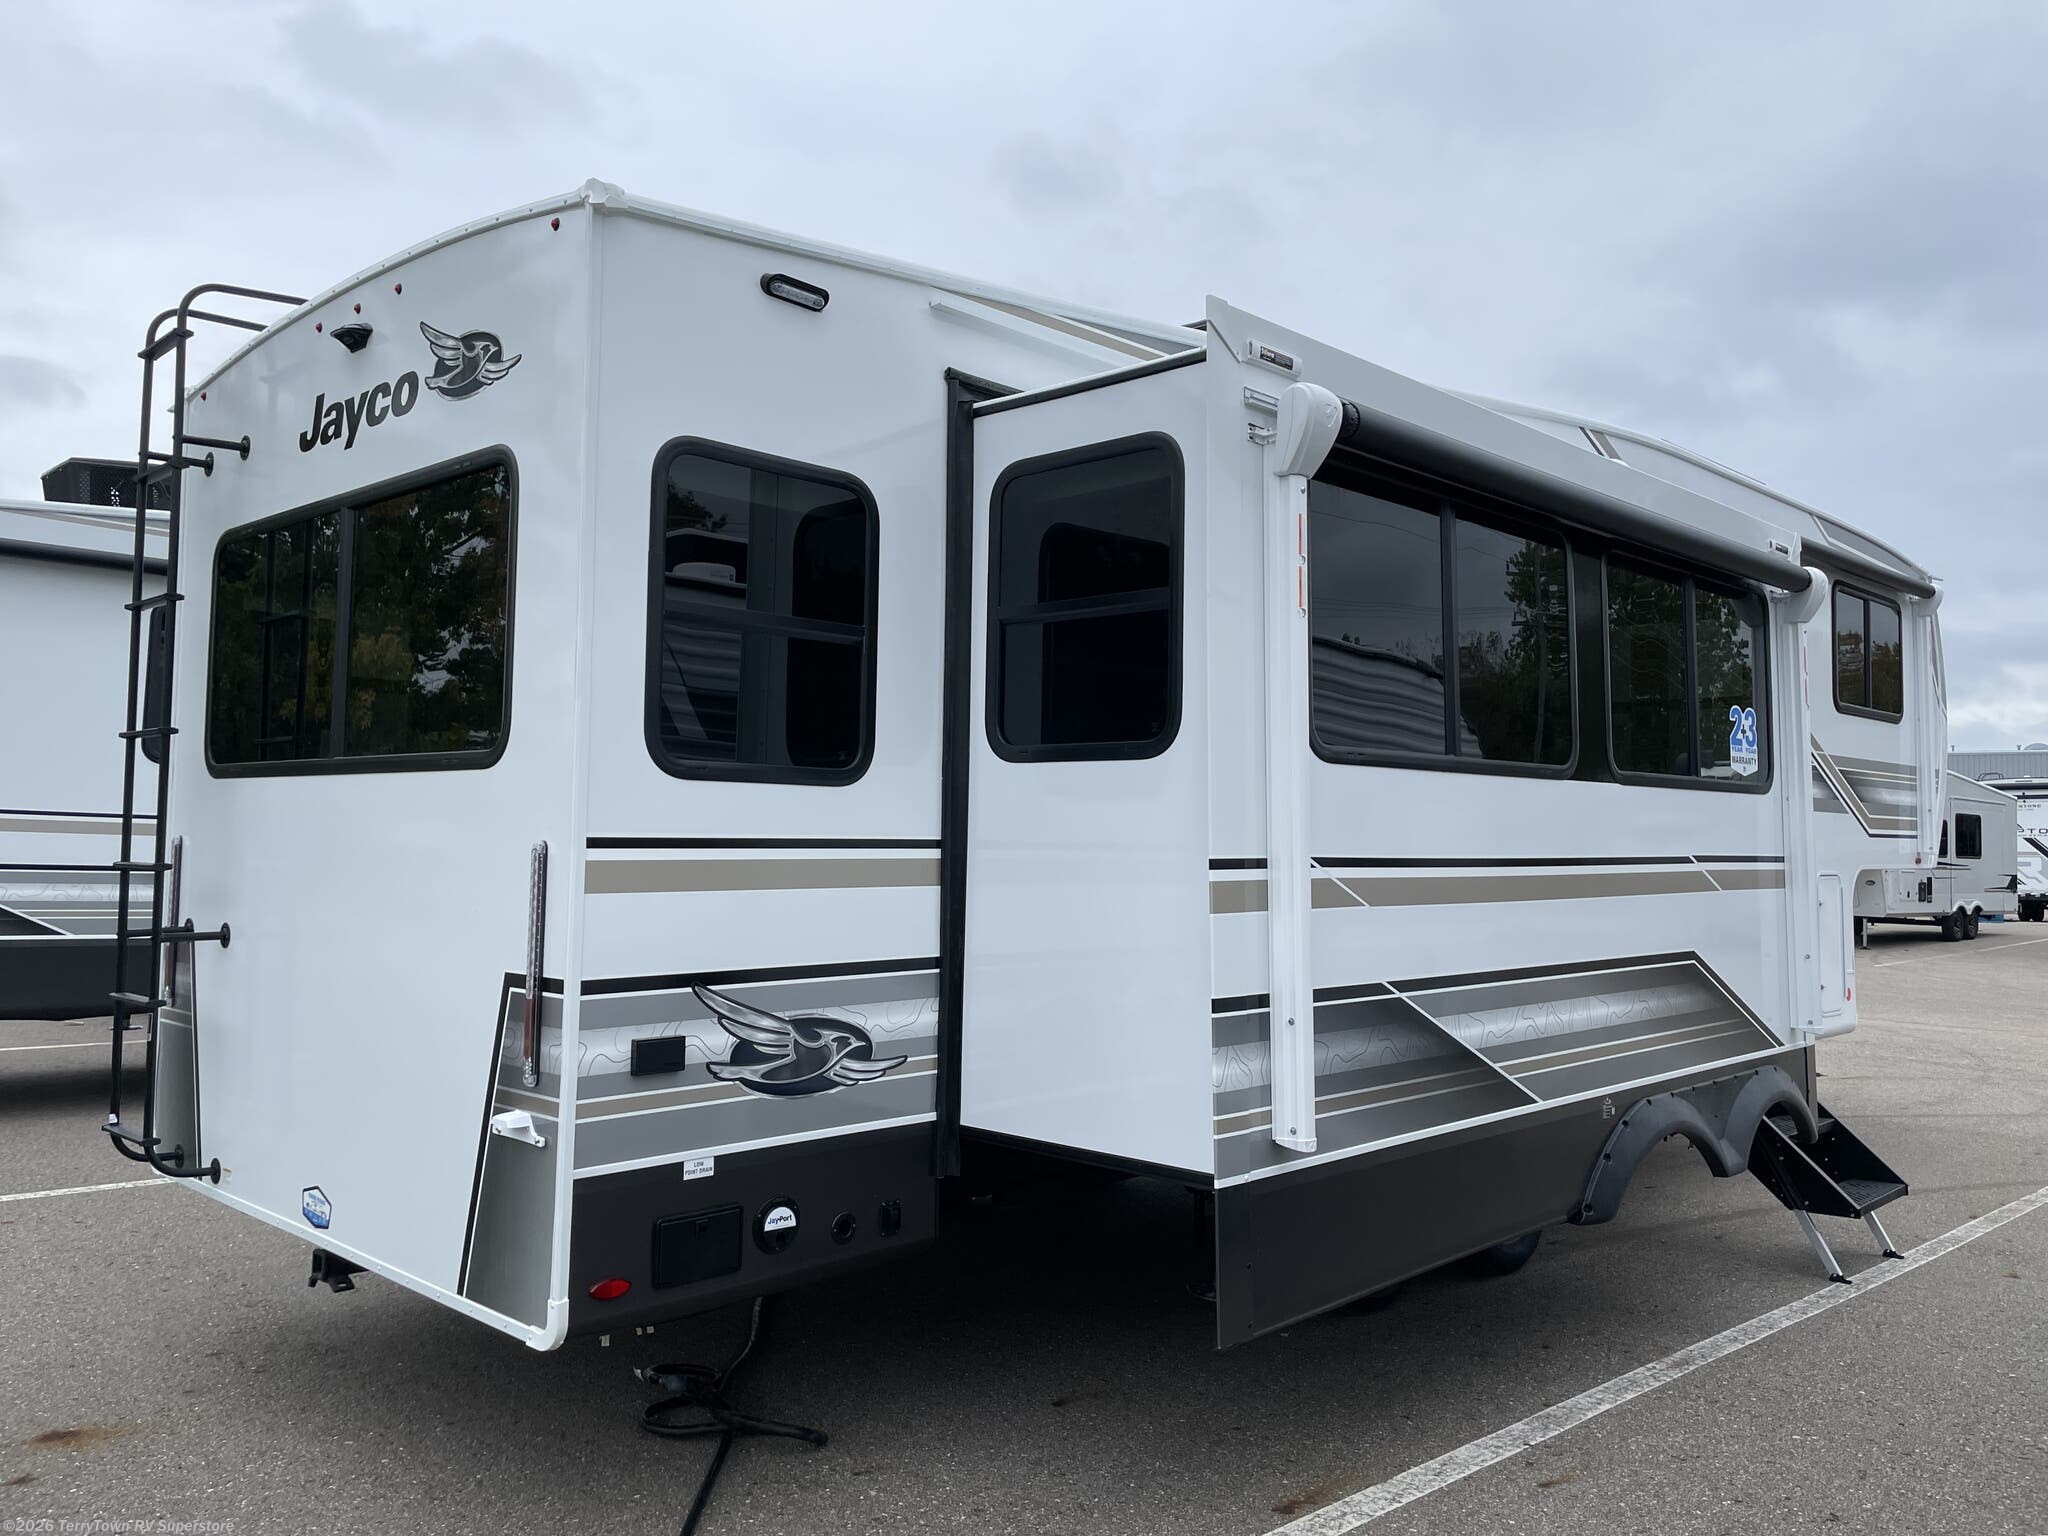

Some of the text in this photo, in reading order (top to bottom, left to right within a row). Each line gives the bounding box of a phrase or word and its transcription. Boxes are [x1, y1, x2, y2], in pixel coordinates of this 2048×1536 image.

[299, 371, 419, 453] Jayco
[1732, 756, 1757, 766] WARRANTY
[685, 1168, 698, 1176] POINT
